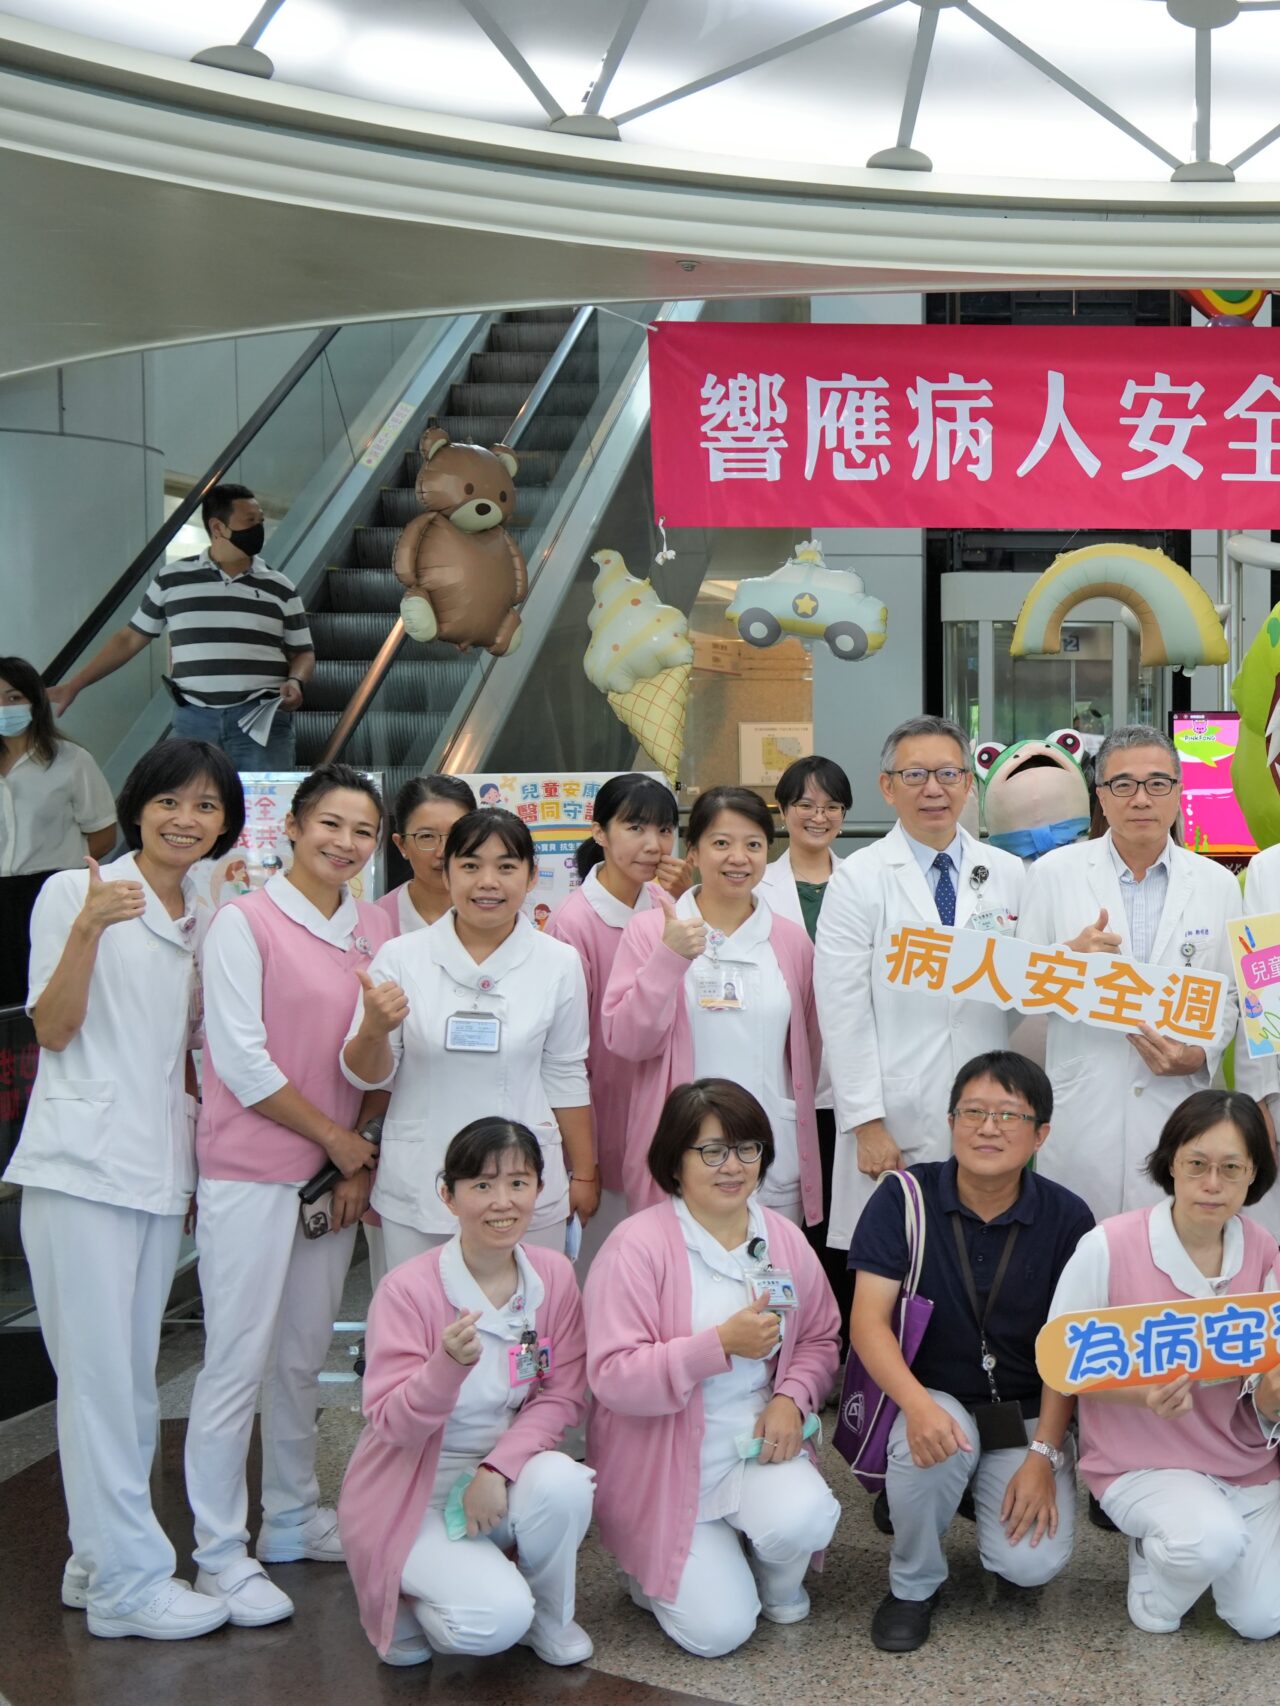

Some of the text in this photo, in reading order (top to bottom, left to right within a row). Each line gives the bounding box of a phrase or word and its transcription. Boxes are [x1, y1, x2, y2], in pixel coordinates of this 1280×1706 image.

[885, 927, 1223, 1041] 病人安全週
